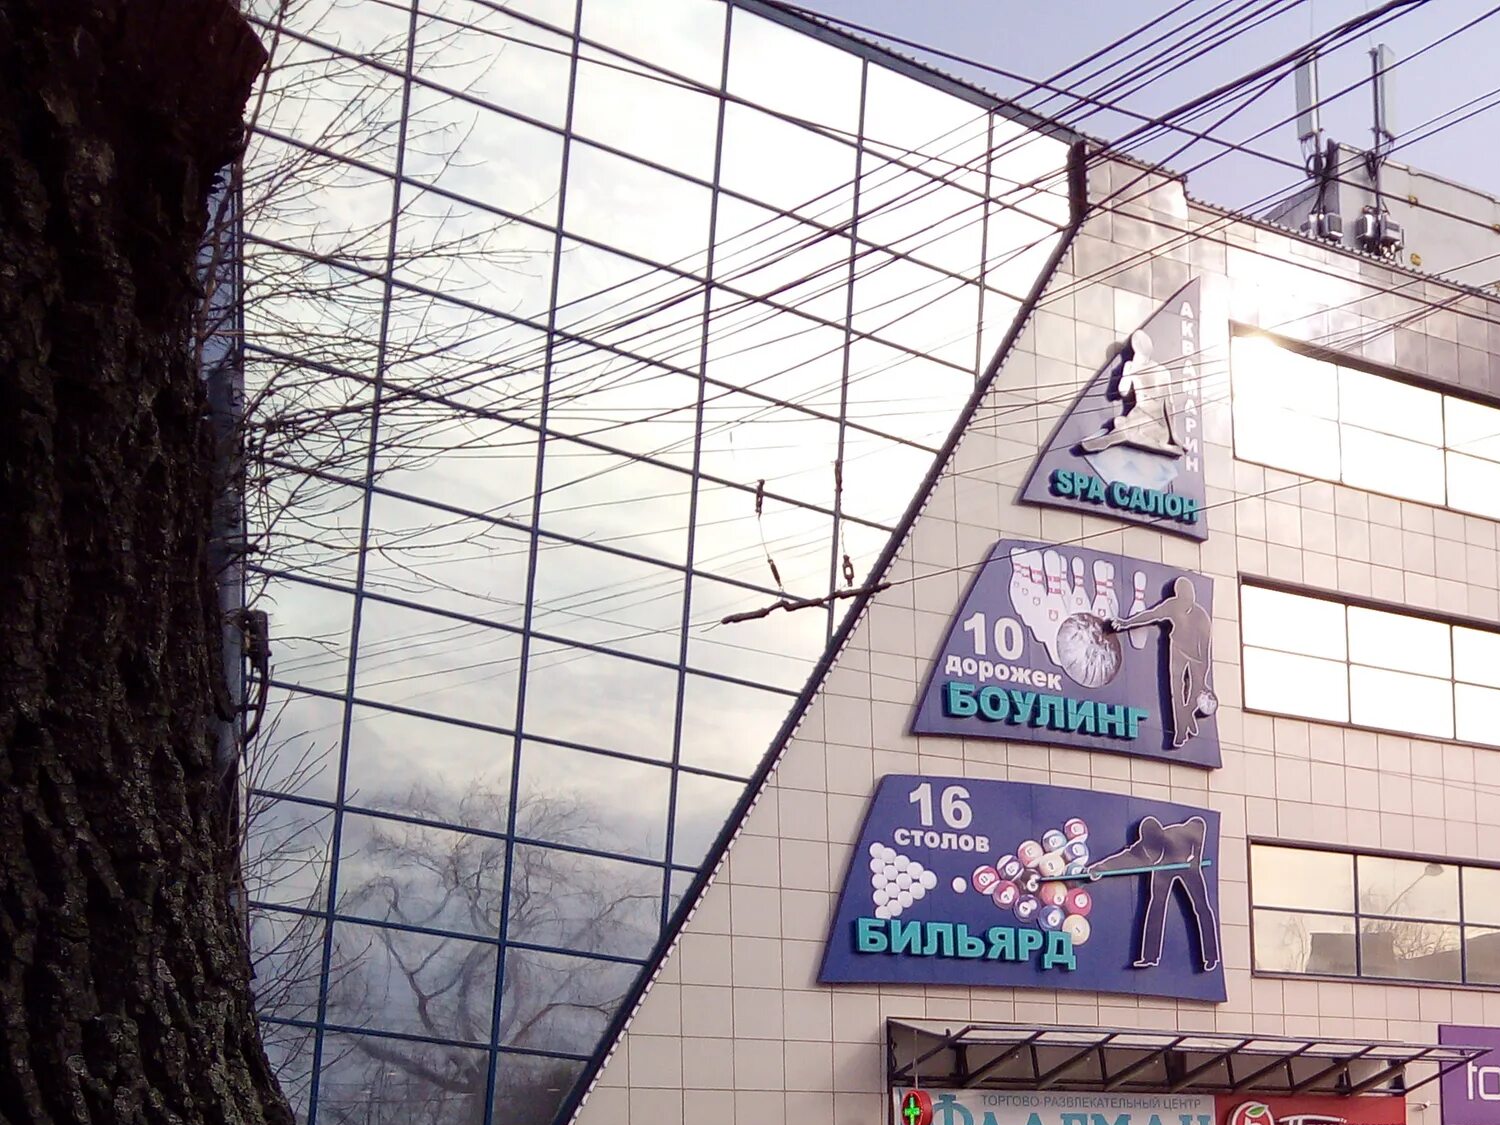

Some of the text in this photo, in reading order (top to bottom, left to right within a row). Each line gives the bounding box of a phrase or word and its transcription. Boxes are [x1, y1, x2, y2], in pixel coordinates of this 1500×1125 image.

[1055, 469, 1200, 523] SPA САЛОН
[963, 612, 1024, 660] 10
[945, 654, 1063, 691] дорожек
[948, 681, 1149, 739] БОУЛИНГ
[909, 783, 973, 829] 16
[894, 828, 990, 852] столов
[856, 917, 1077, 970] БИЛЬЯРД
[1163, 1097, 1201, 1110] ЦЕНТР
